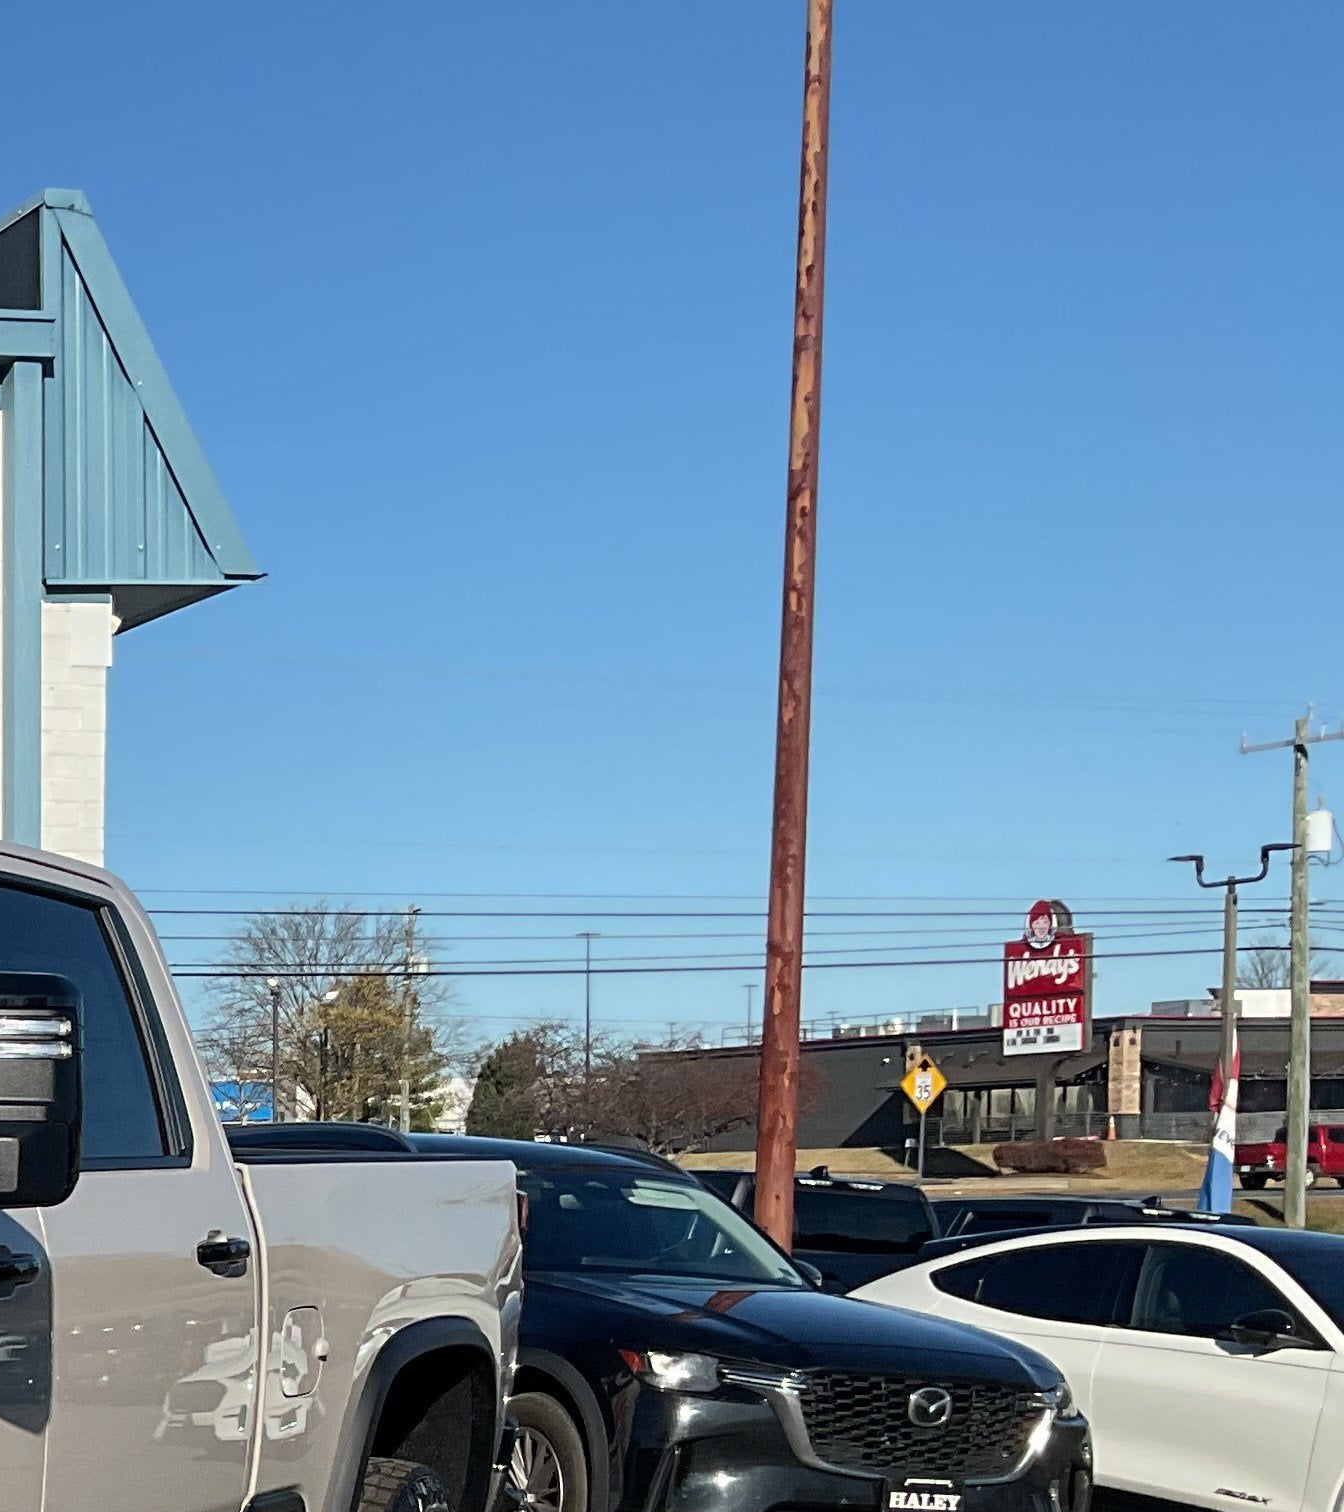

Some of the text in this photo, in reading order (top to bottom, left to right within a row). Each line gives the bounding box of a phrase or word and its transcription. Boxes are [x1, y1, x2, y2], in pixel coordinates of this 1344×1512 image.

[1007, 944, 1080, 990] Wendy's
[1009, 997, 1078, 1018] QUALITY
[1020, 1016, 1040, 1027] OUR
[1043, 1013, 1078, 1026] RECIPE
[916, 1084, 931, 1101] 35
[889, 1491, 961, 1511] HALEY
